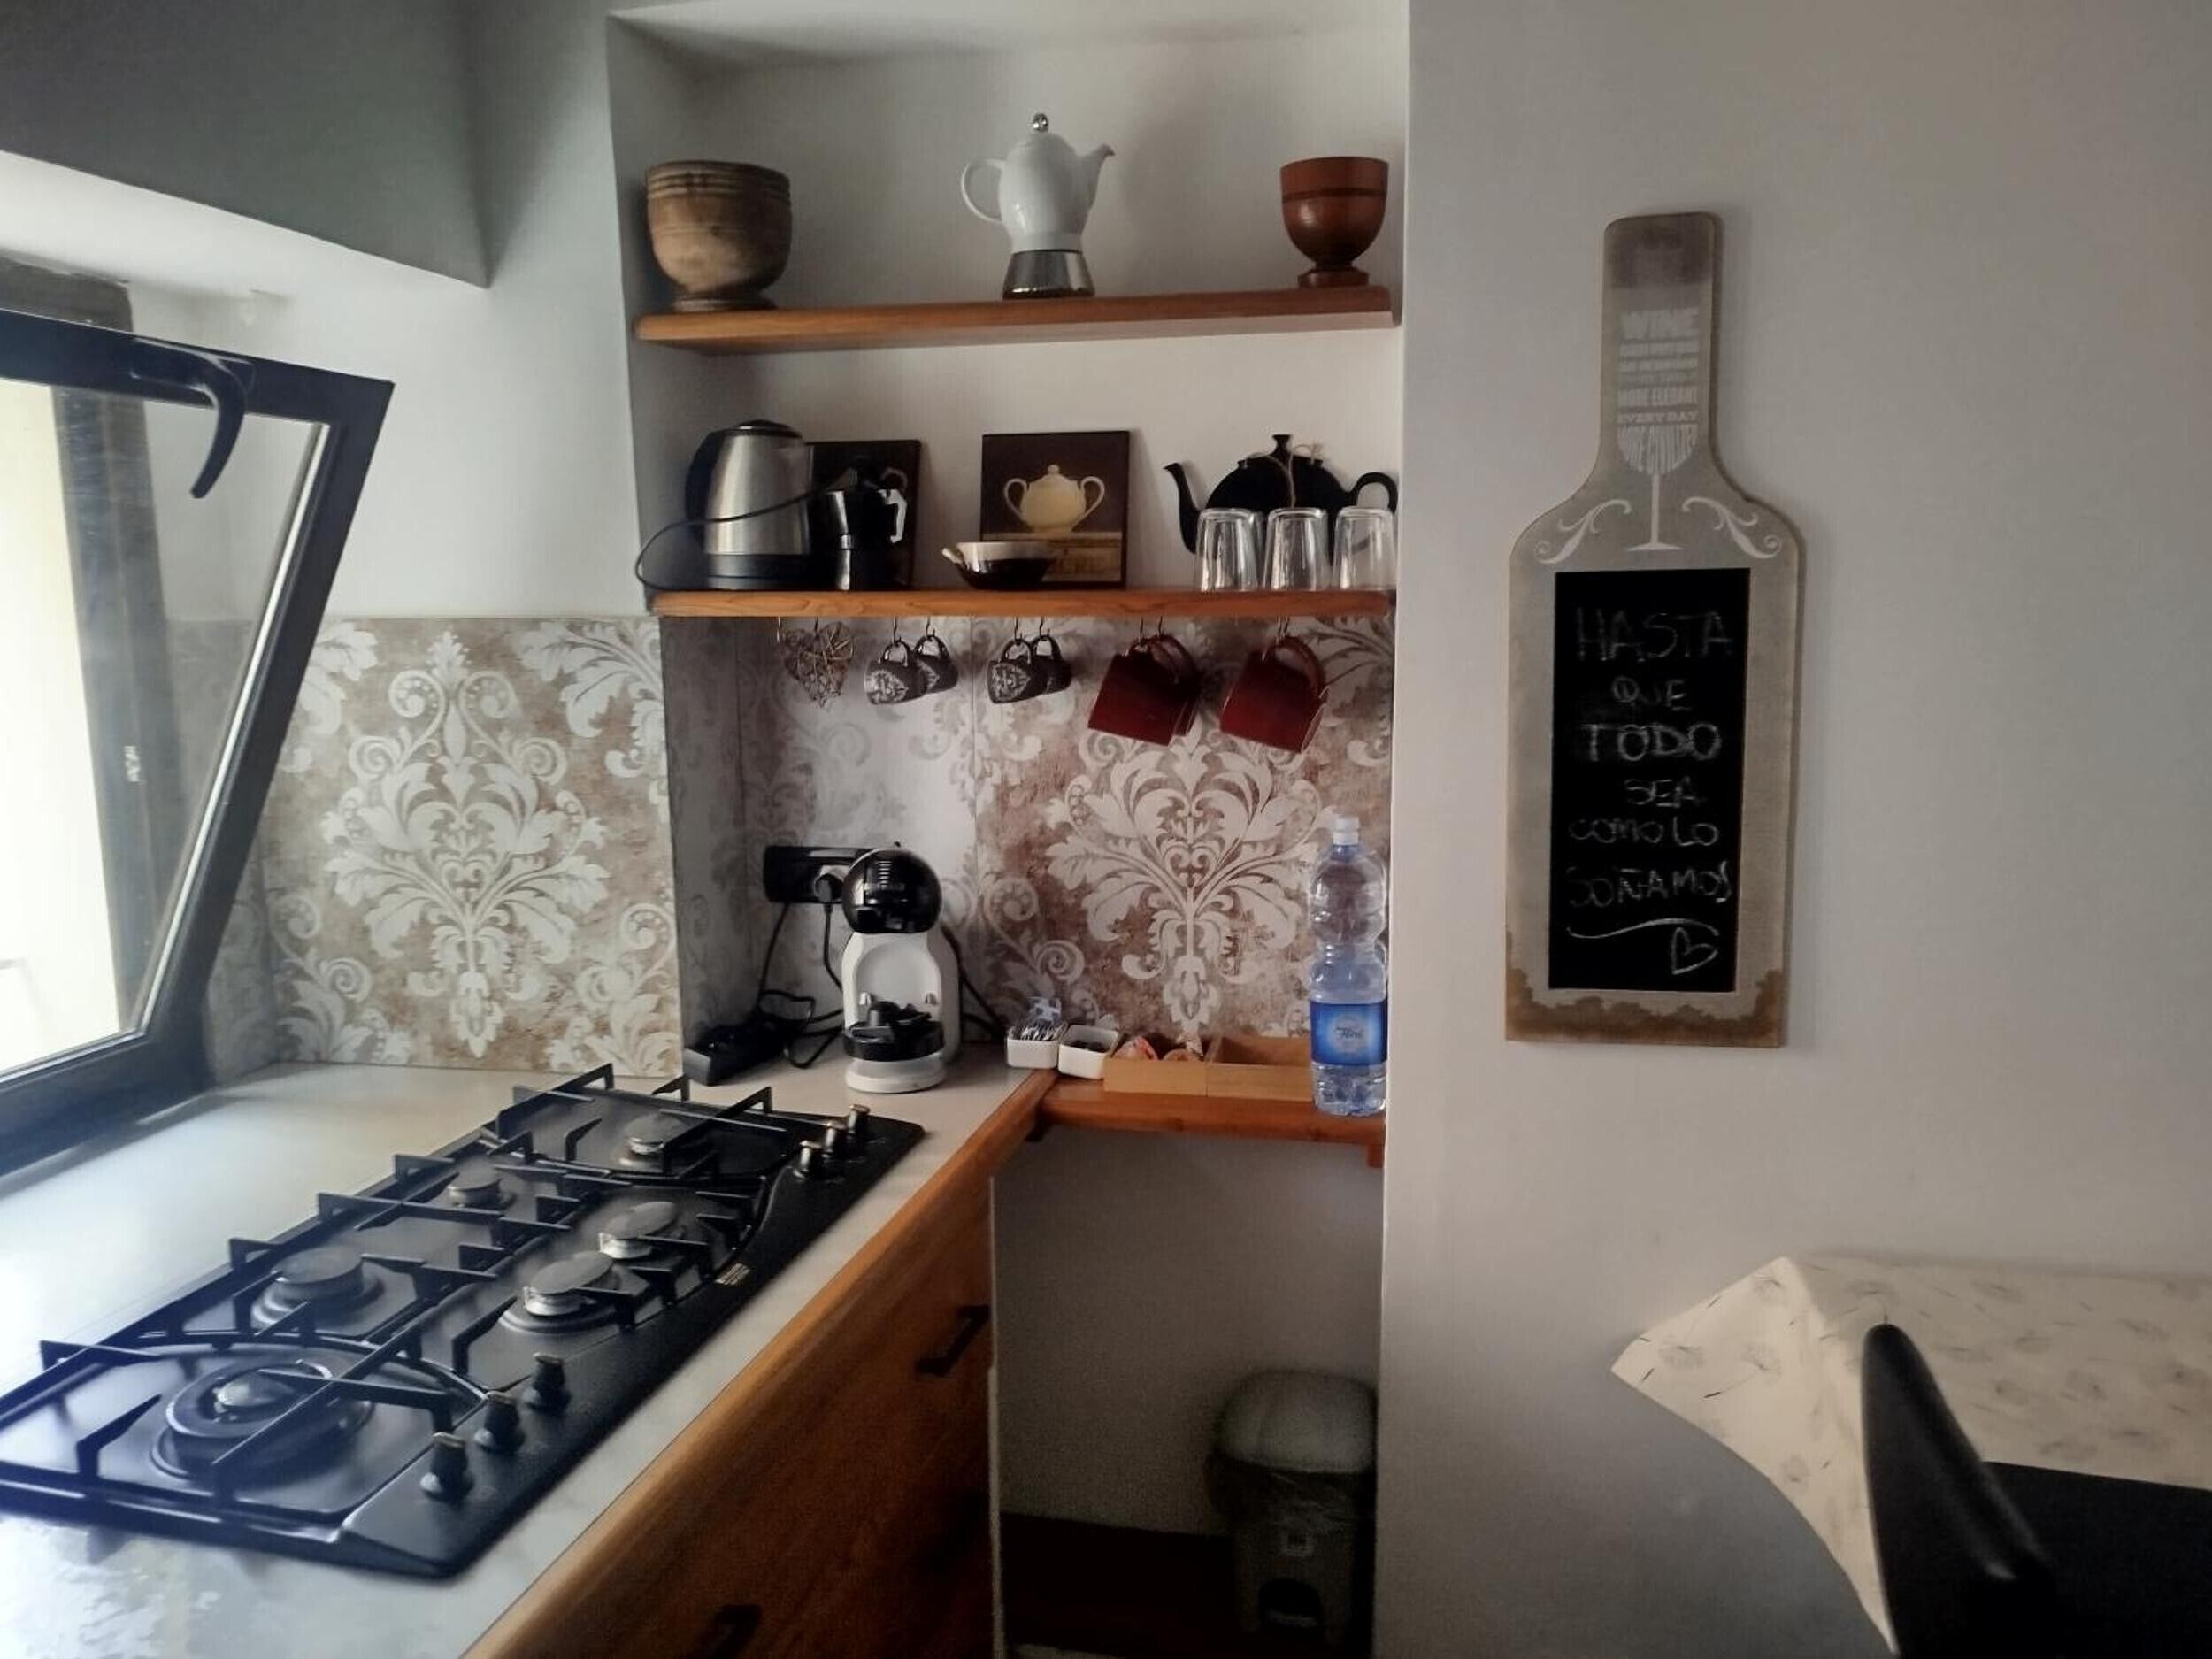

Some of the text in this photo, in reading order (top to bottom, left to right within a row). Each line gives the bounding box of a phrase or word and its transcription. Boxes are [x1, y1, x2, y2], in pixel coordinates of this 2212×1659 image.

[1620, 307, 1699, 340] WINE
[1577, 607, 1733, 662] HASTA
[1611, 675, 1692, 711] QUE
[1580, 721, 1723, 761] TODO
[1624, 776, 1707, 809] SEA
[1565, 860, 1732, 908] SOÑAMOS
